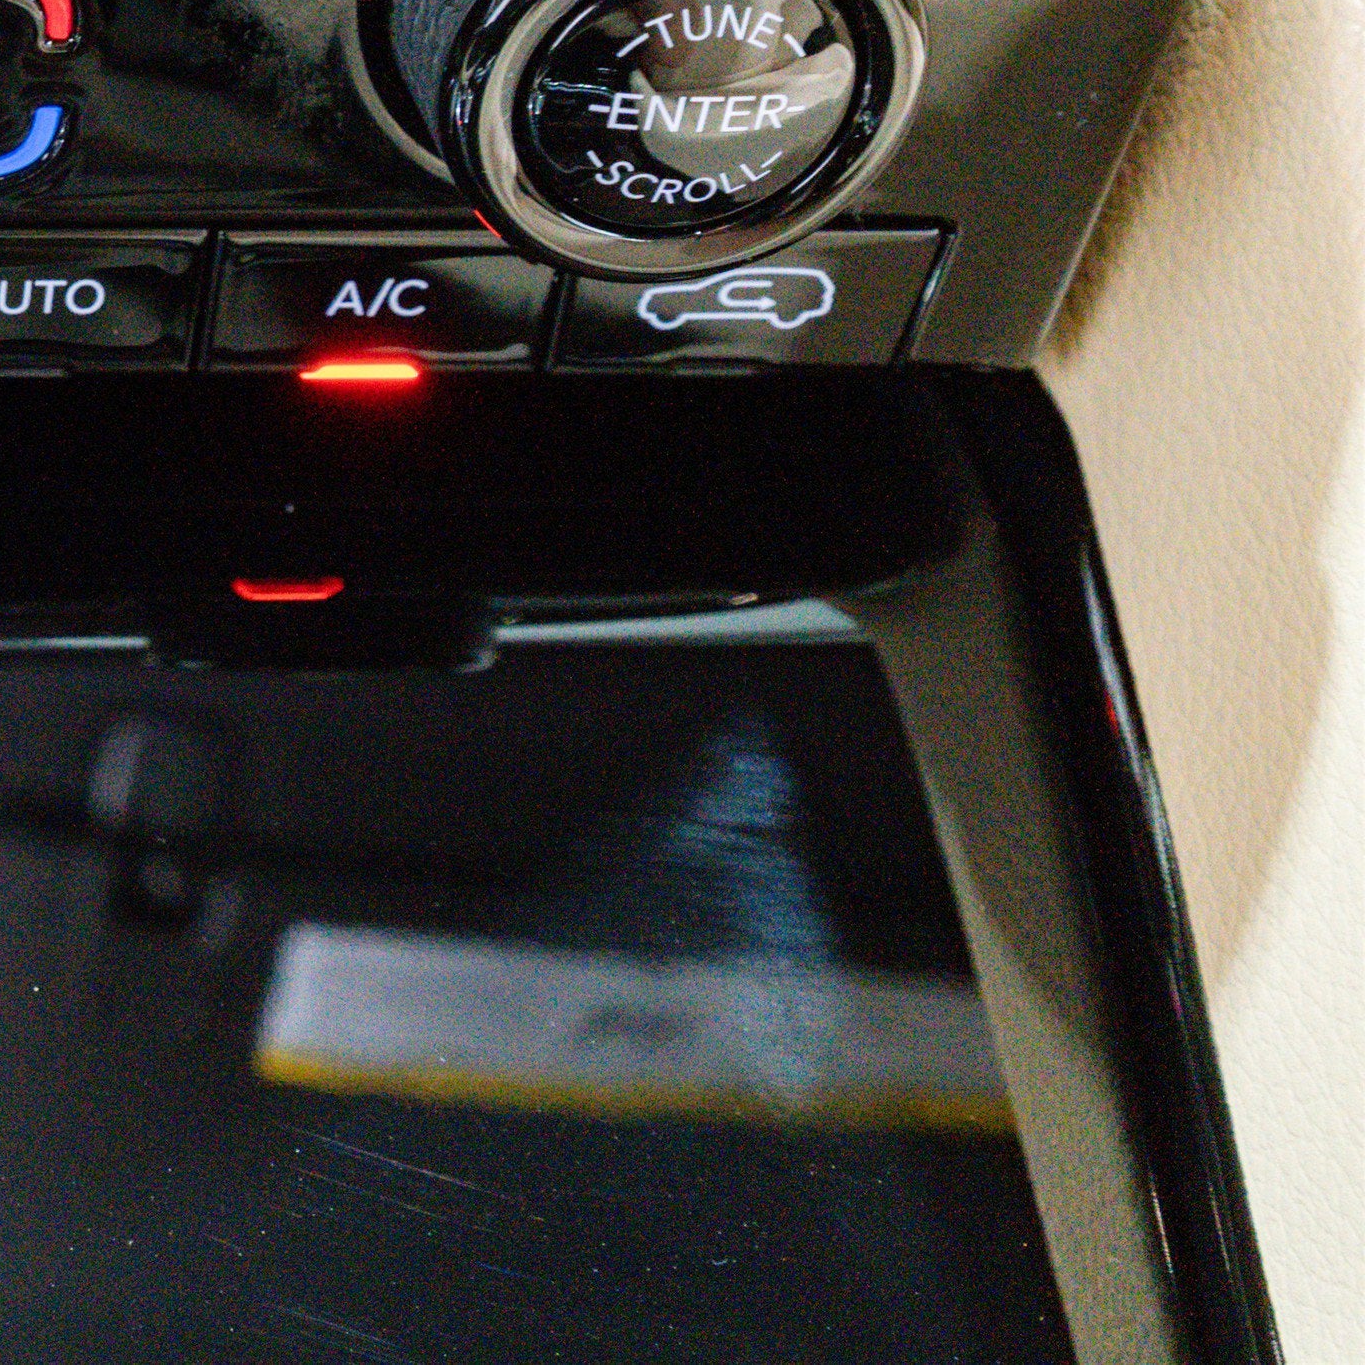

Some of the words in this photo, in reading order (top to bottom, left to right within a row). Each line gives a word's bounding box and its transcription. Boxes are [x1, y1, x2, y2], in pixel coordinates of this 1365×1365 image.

[644, 4, 784, 49] TUNE
[606, 93, 789, 133] ENTER
[595, 160, 771, 204] SCROLL
[326, 279, 428, 318] A/C
